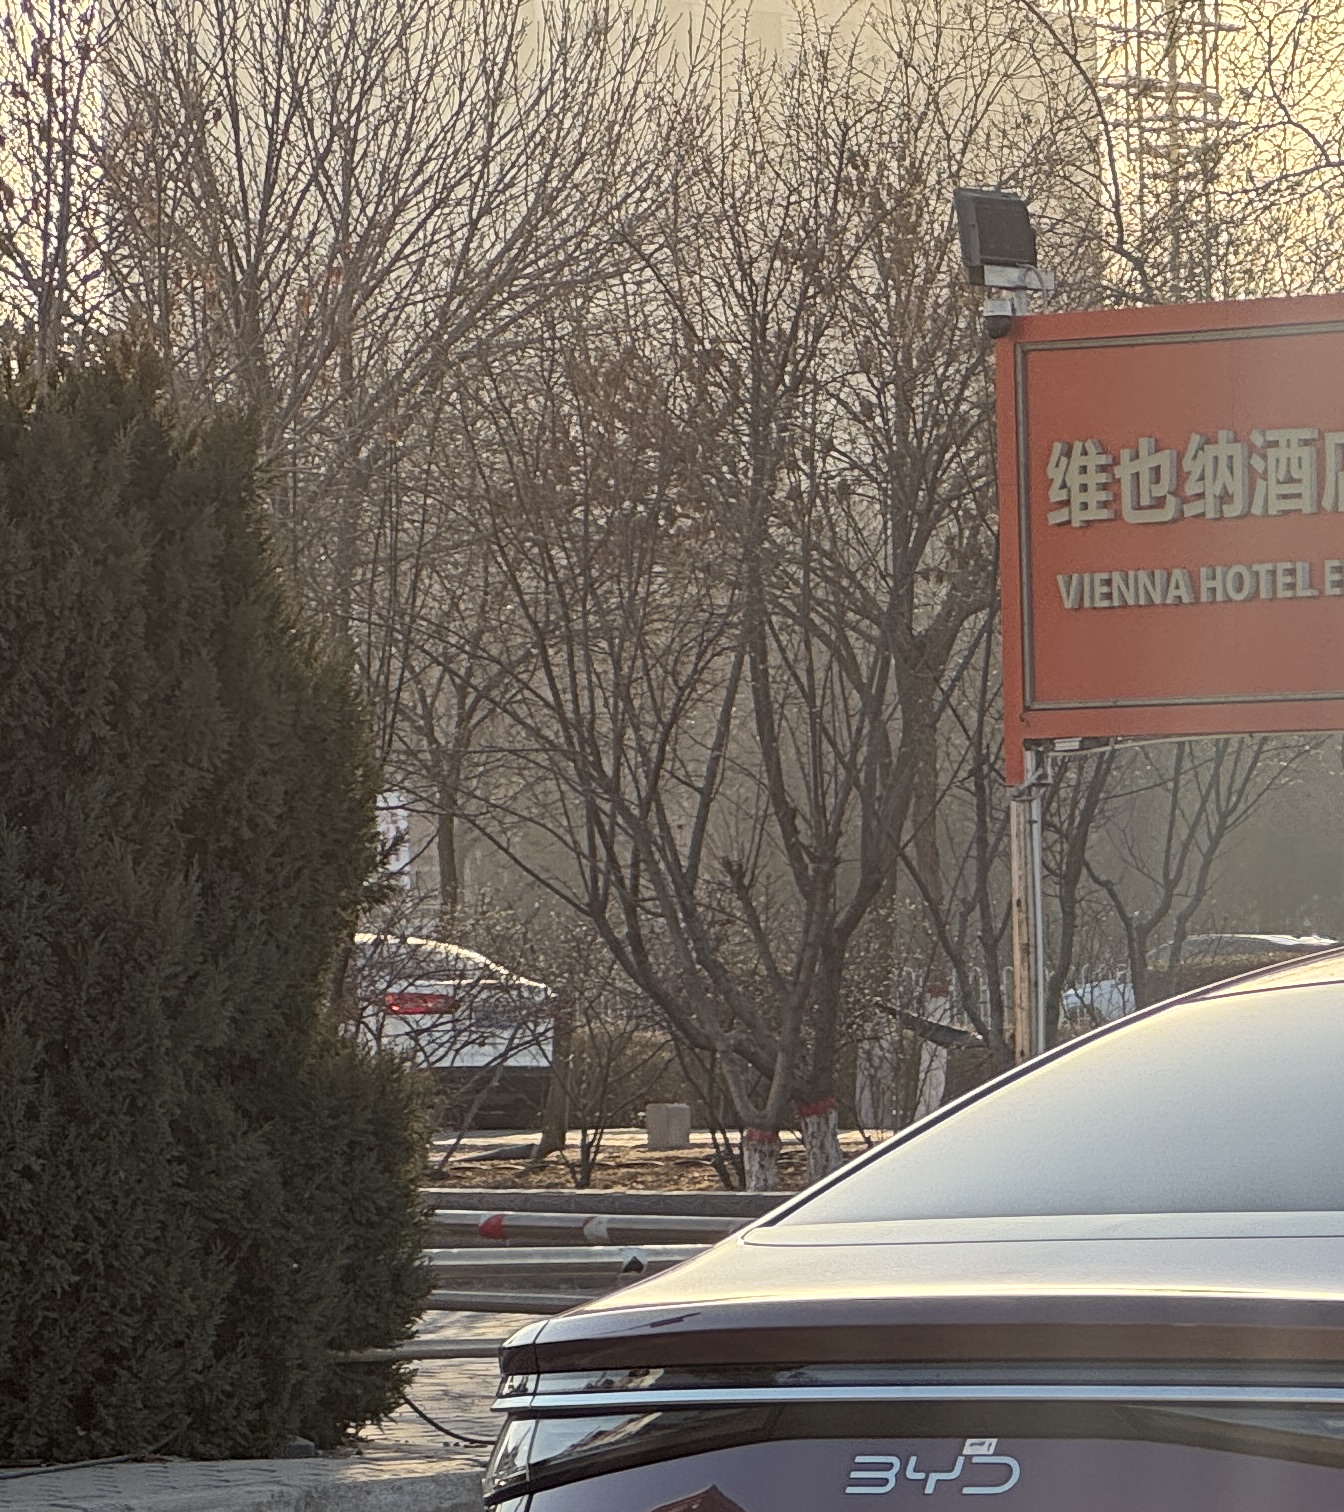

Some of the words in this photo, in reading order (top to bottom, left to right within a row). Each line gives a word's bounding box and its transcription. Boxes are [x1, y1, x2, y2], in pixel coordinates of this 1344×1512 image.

[1056, 566, 1195, 611] VIENNA
[1200, 558, 1318, 604] HOTEL
[845, 1455, 1021, 1495] BYD
